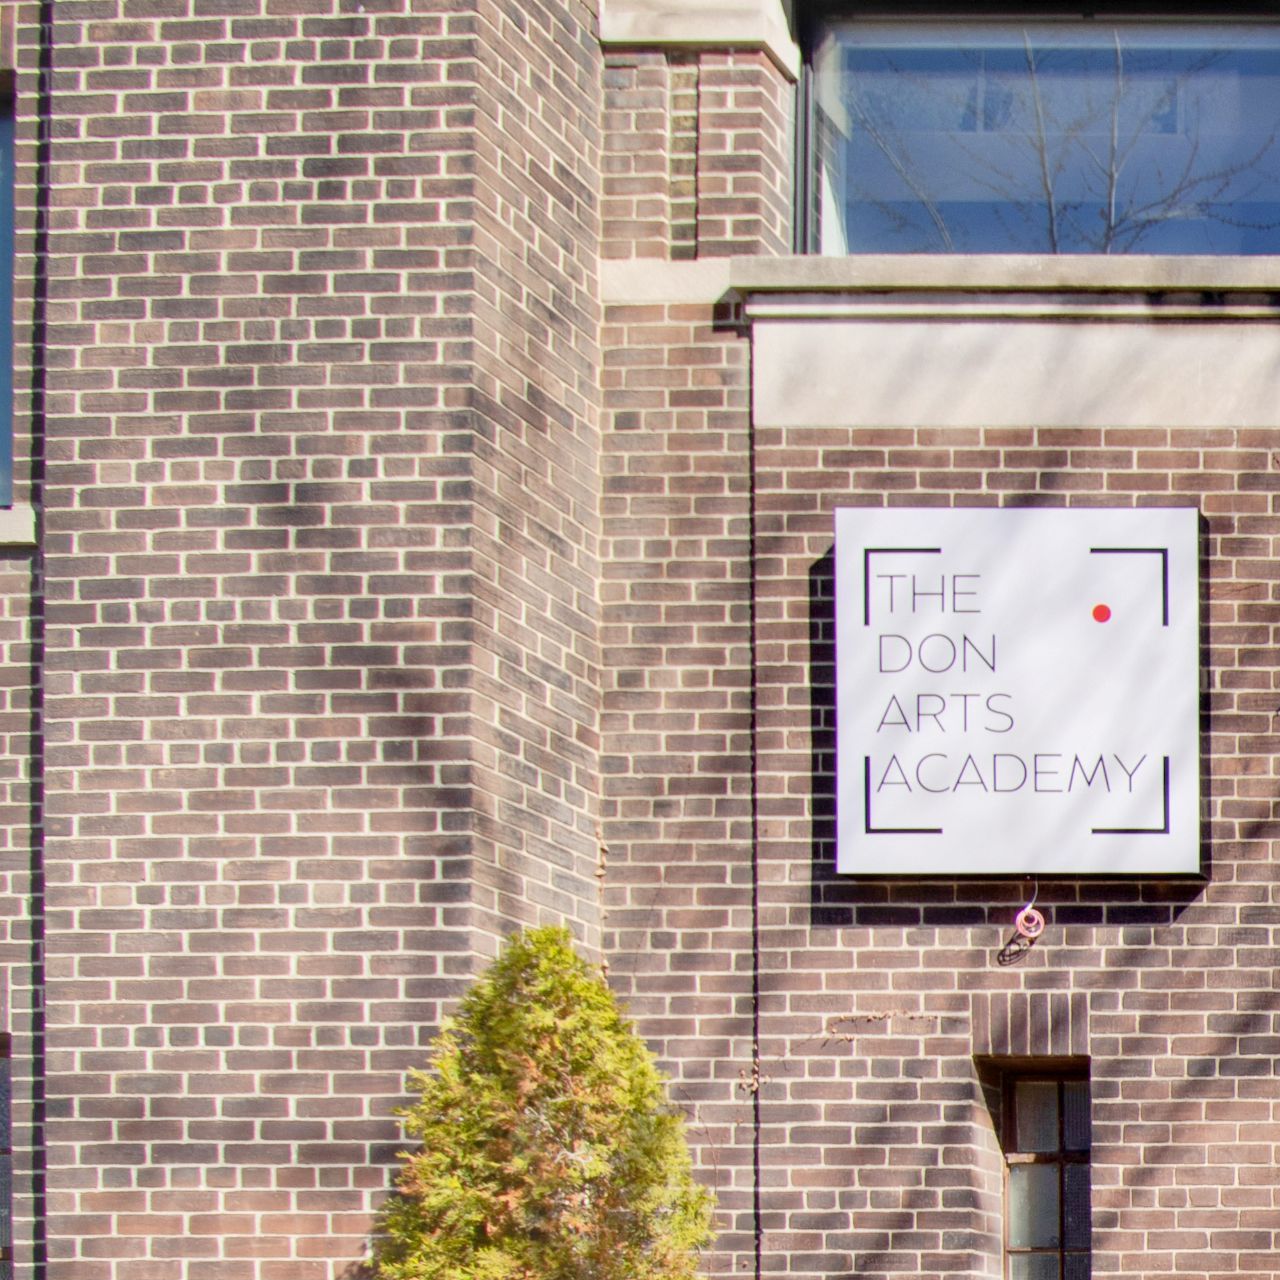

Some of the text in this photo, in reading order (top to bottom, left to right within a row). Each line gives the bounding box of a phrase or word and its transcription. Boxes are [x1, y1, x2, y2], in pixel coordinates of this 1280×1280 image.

[876, 574, 981, 613] THE
[879, 633, 996, 673] DON
[876, 693, 1014, 733] ARTS
[876, 753, 1147, 793] ACADEMY
